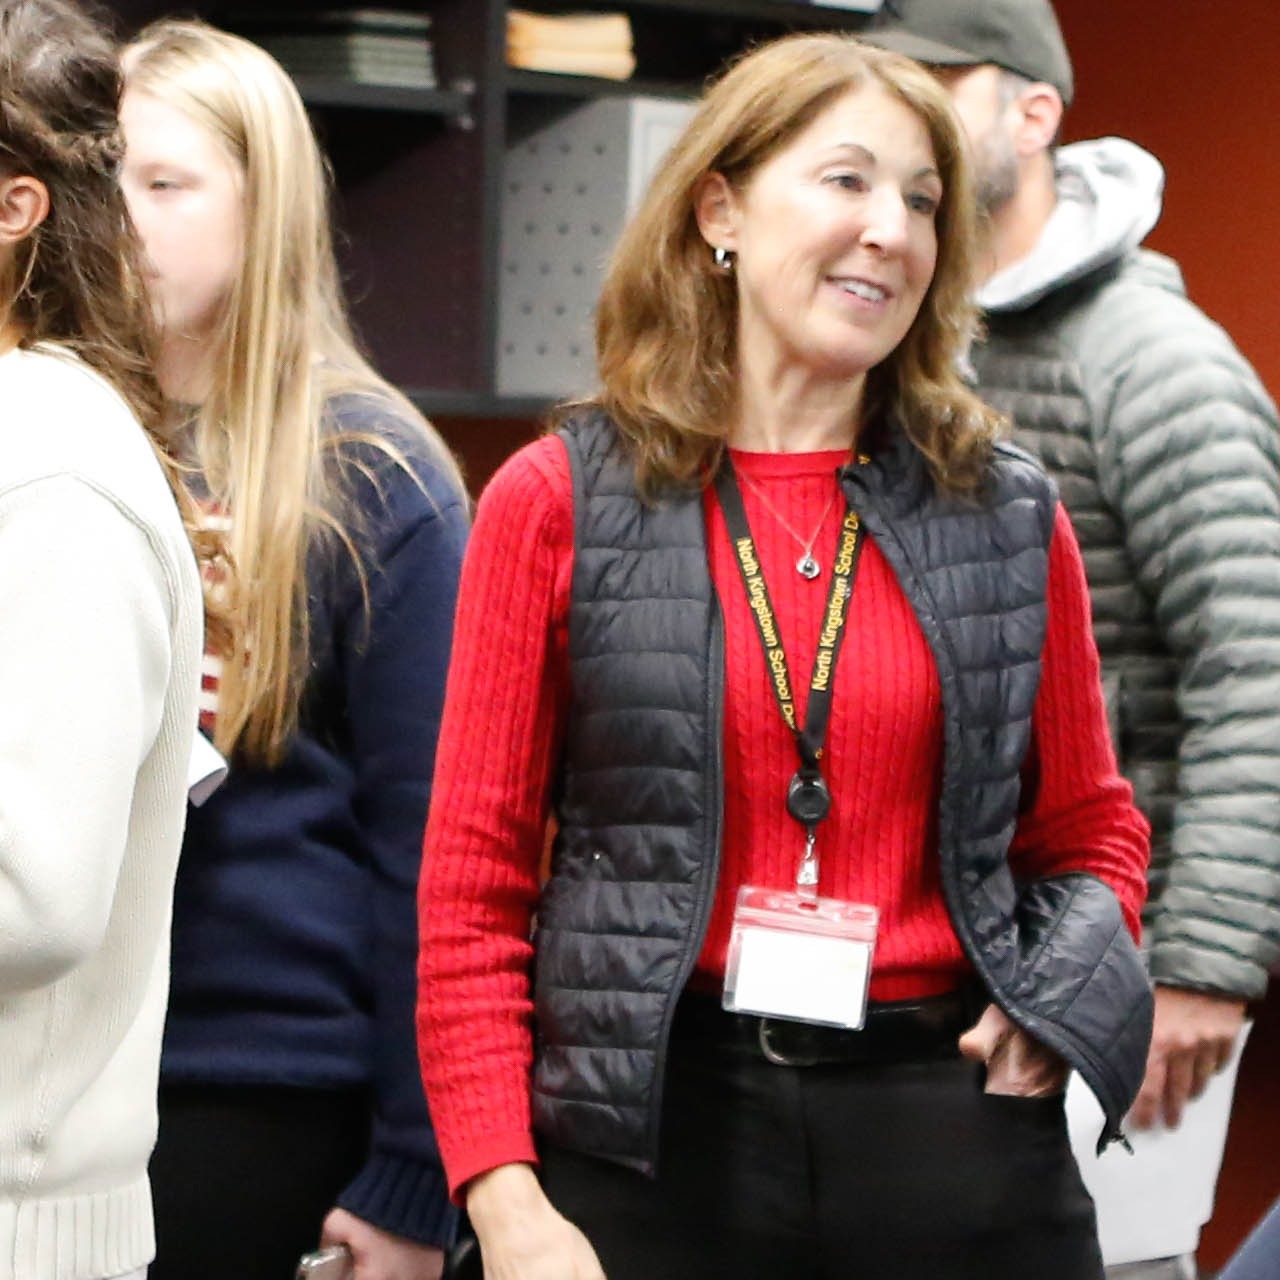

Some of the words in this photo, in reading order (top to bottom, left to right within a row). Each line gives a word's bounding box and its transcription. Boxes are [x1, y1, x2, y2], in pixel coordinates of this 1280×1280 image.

[736, 537, 760, 577] North
[834, 529, 858, 577] School
[747, 576, 779, 647] Kingstown
[820, 577, 848, 647] Kingstown
[769, 650, 792, 701] School
[811, 647, 833, 691] North
